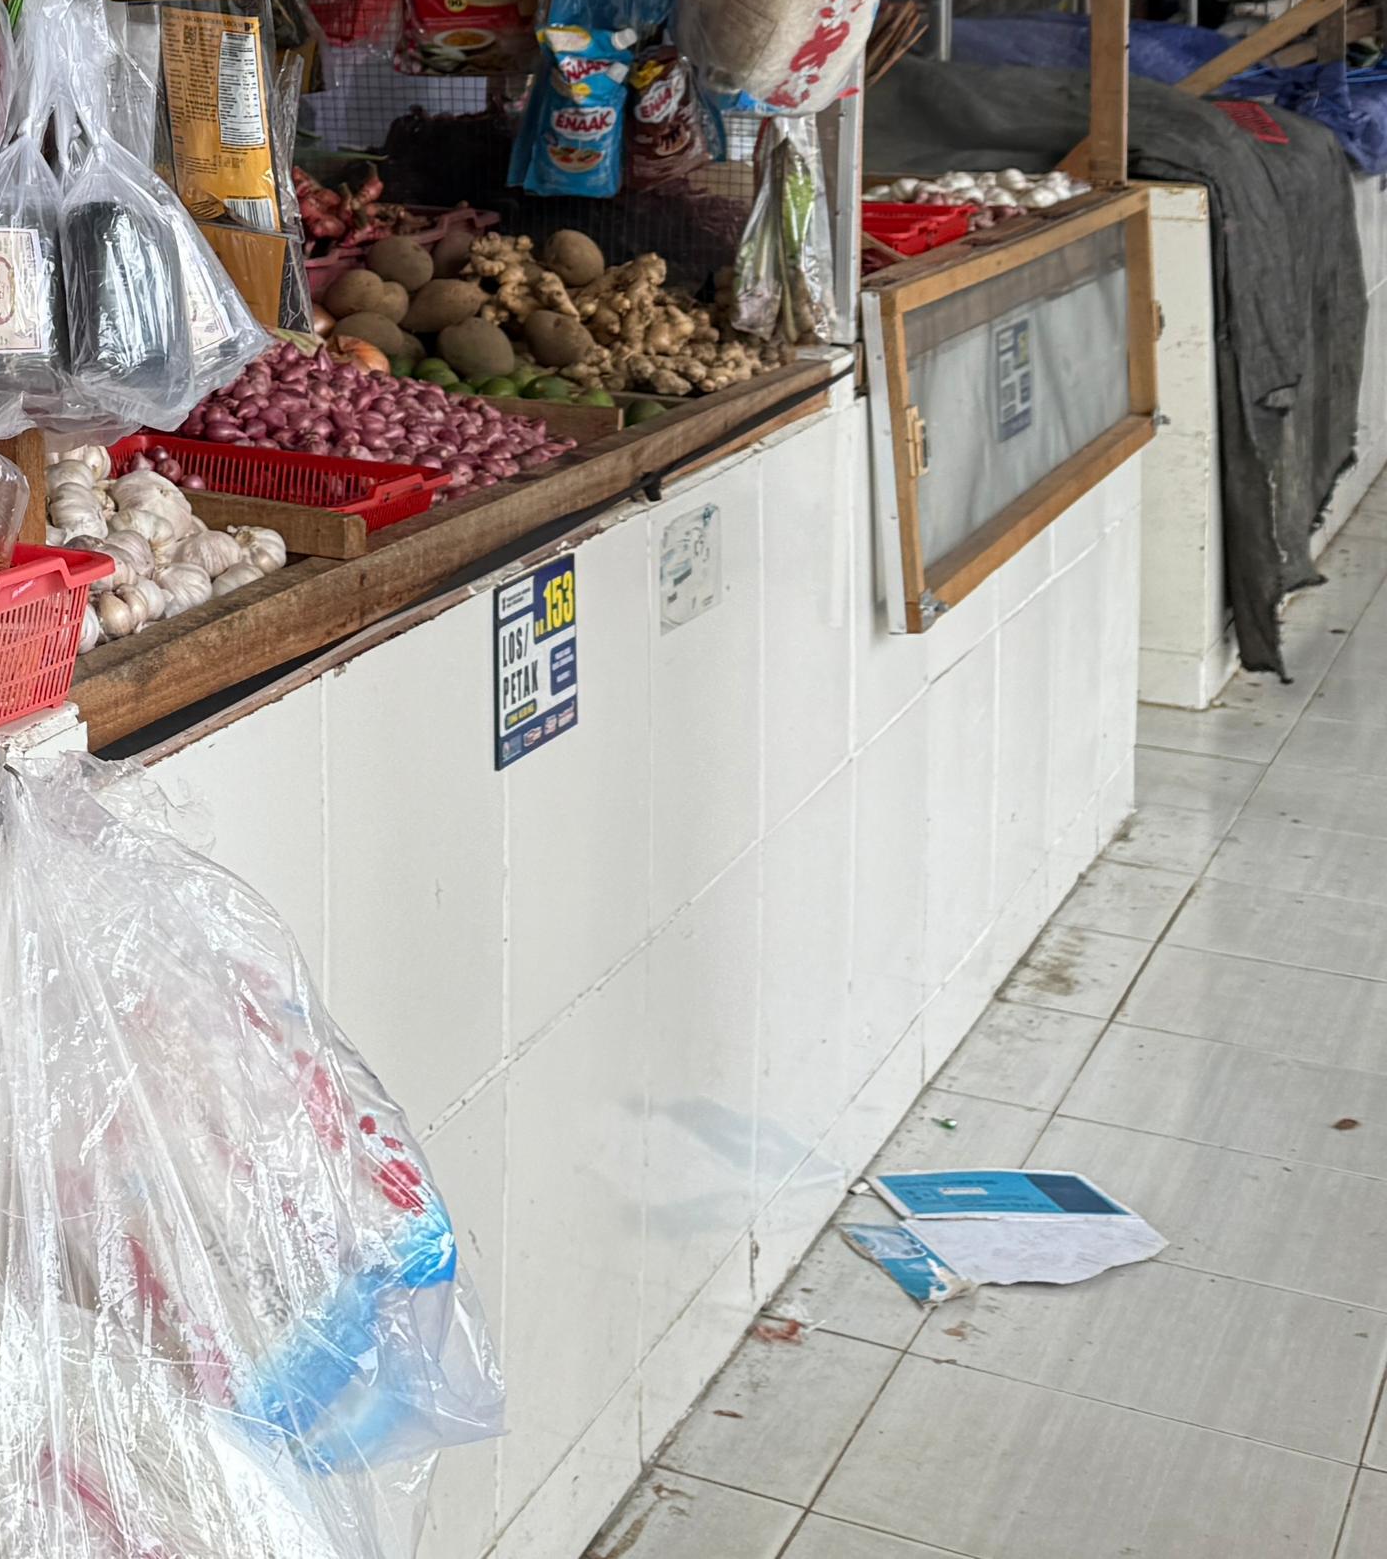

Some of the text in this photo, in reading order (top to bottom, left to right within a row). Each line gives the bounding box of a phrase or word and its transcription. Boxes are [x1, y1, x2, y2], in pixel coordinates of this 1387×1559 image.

[554, 109, 613, 134] ENAAK
[502, 621, 530, 669] LOS/
[502, 658, 540, 711] PETAK
